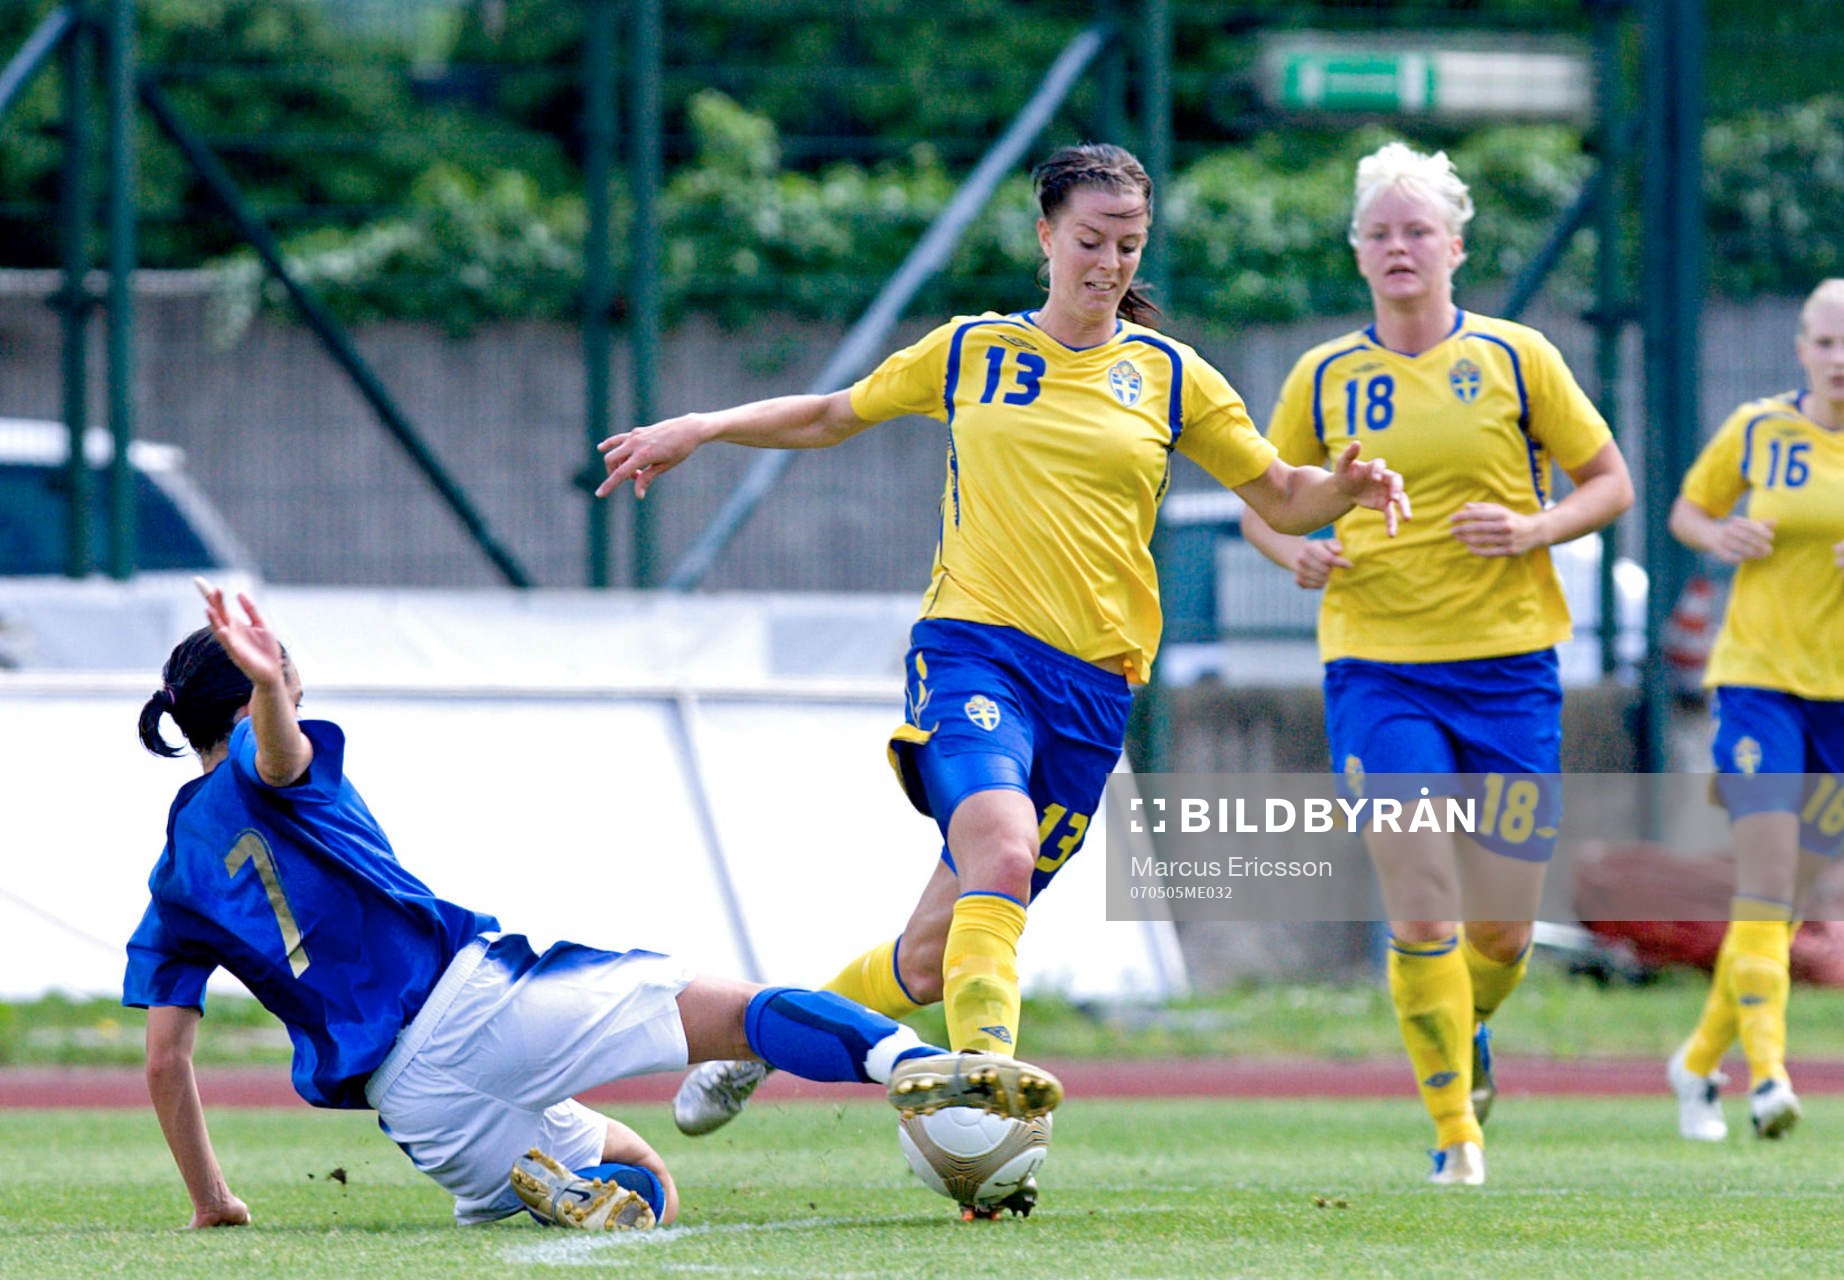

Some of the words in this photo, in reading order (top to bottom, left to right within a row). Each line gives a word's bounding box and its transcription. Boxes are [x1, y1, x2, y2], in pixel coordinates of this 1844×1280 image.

[979, 346, 1047, 406] 13
[1344, 374, 1395, 436] 18
[1765, 439, 1813, 489] 16
[1034, 802, 1089, 873] 13
[1479, 772, 1540, 844] 18
[223, 827, 311, 980] 7
